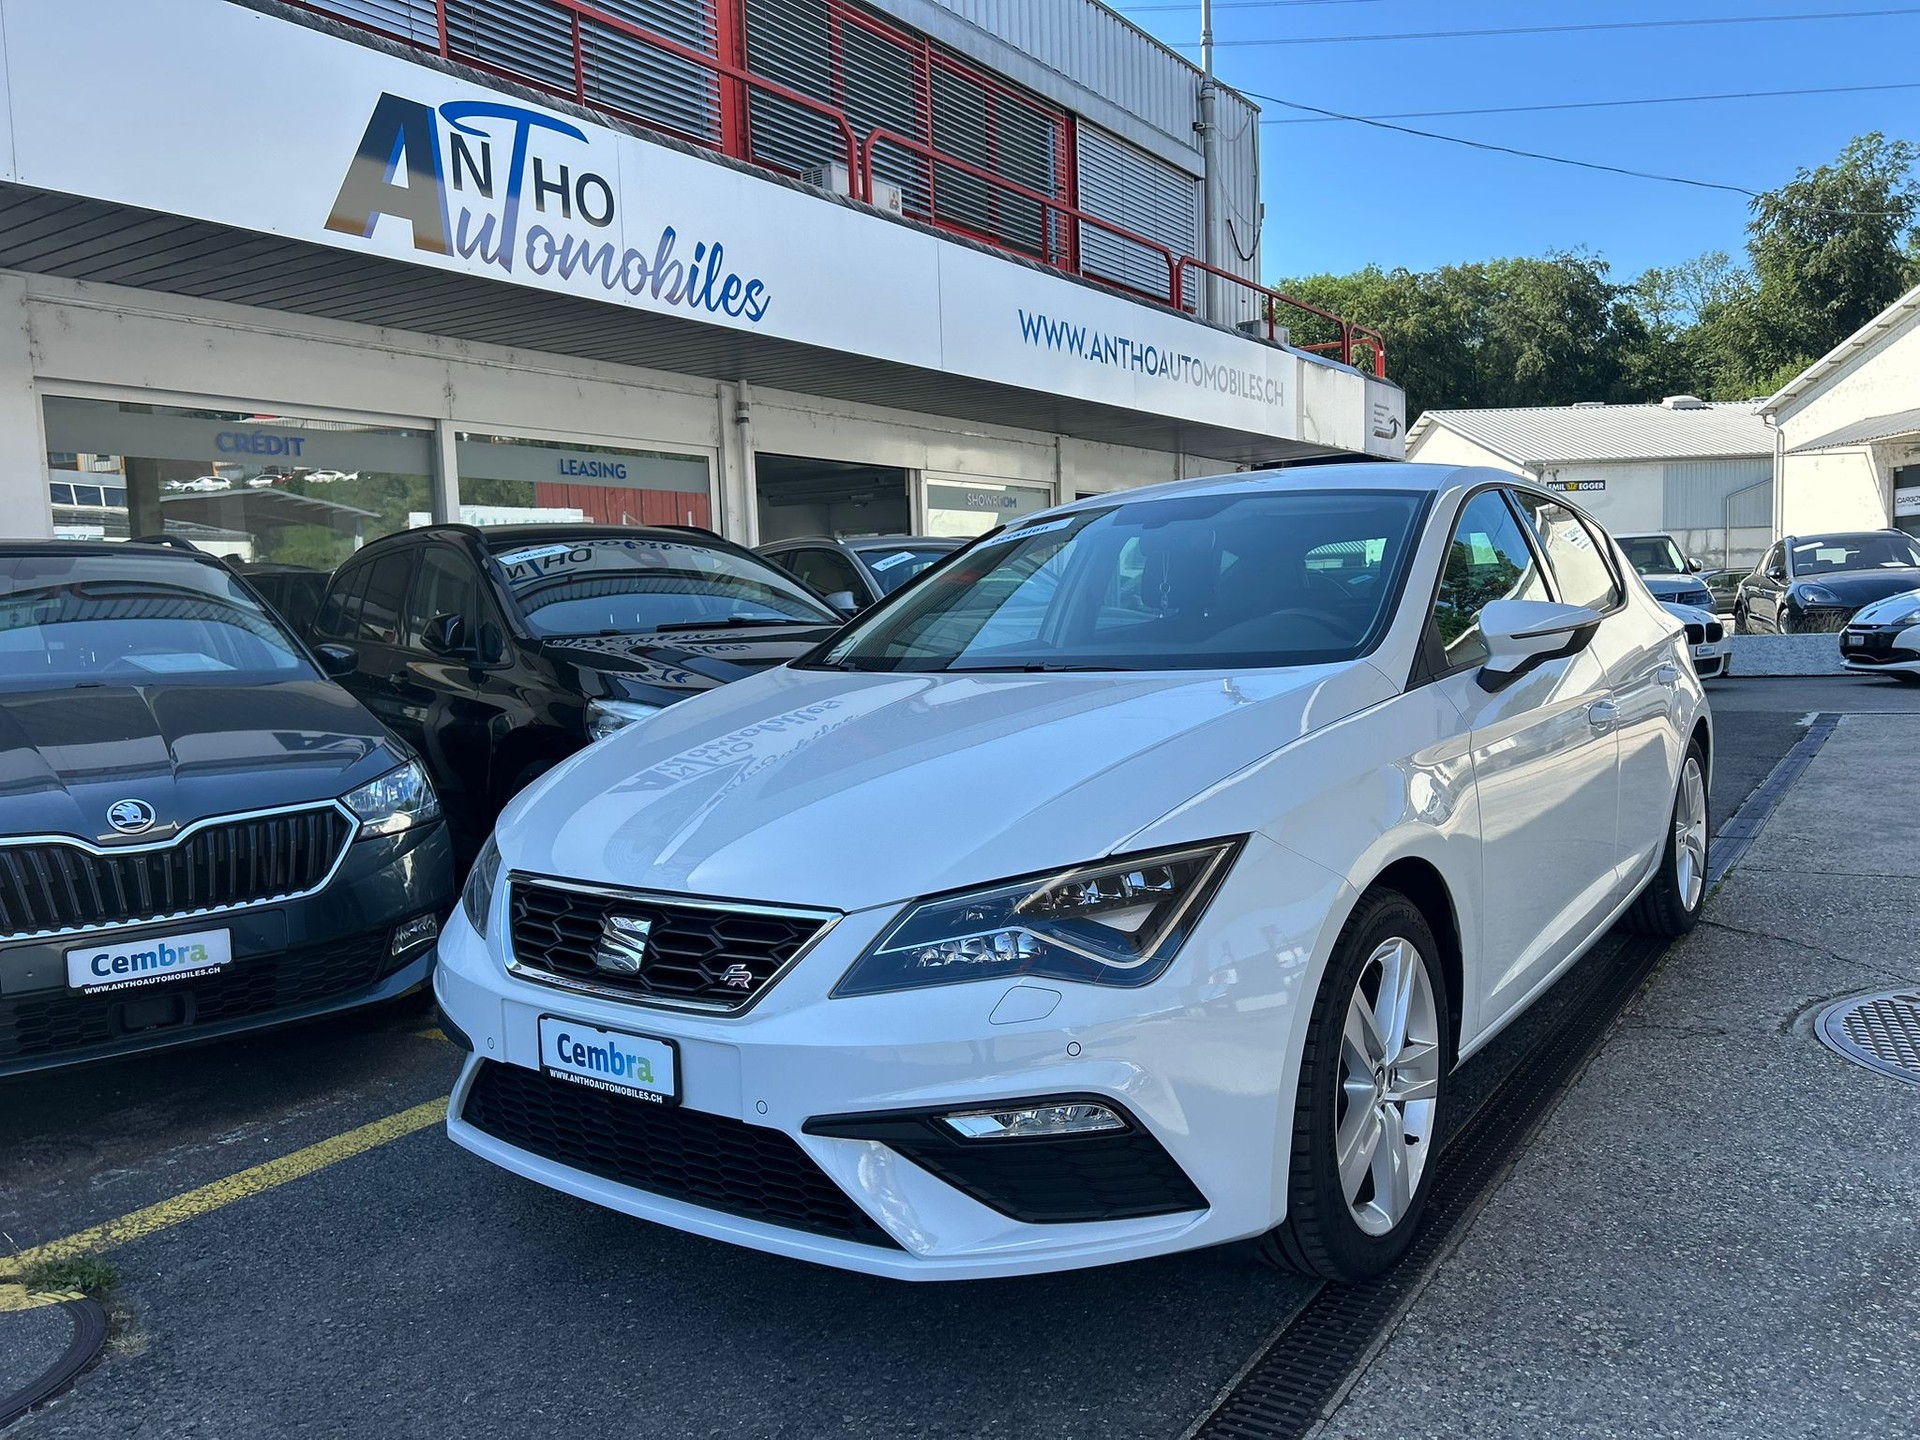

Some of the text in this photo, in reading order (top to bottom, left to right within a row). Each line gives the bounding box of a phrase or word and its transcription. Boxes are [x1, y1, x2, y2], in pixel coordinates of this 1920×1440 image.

[324, 91, 615, 260] ANTHO
[1018, 308, 1284, 406] WWW.ANTHOAUTOMOBILES.CH
[216, 430, 305, 456] CRÉDIT
[560, 459, 627, 479] LEASING
[1578, 482, 1604, 490] EGGER
[91, 943, 208, 977] Cembra
[84, 966, 221, 995] WWW.ANTHOAUTOMOBILES.CH
[557, 1033, 655, 1083] Cembra
[549, 1069, 663, 1104] WWW.ANTHOAUTOMOBILES.CH
